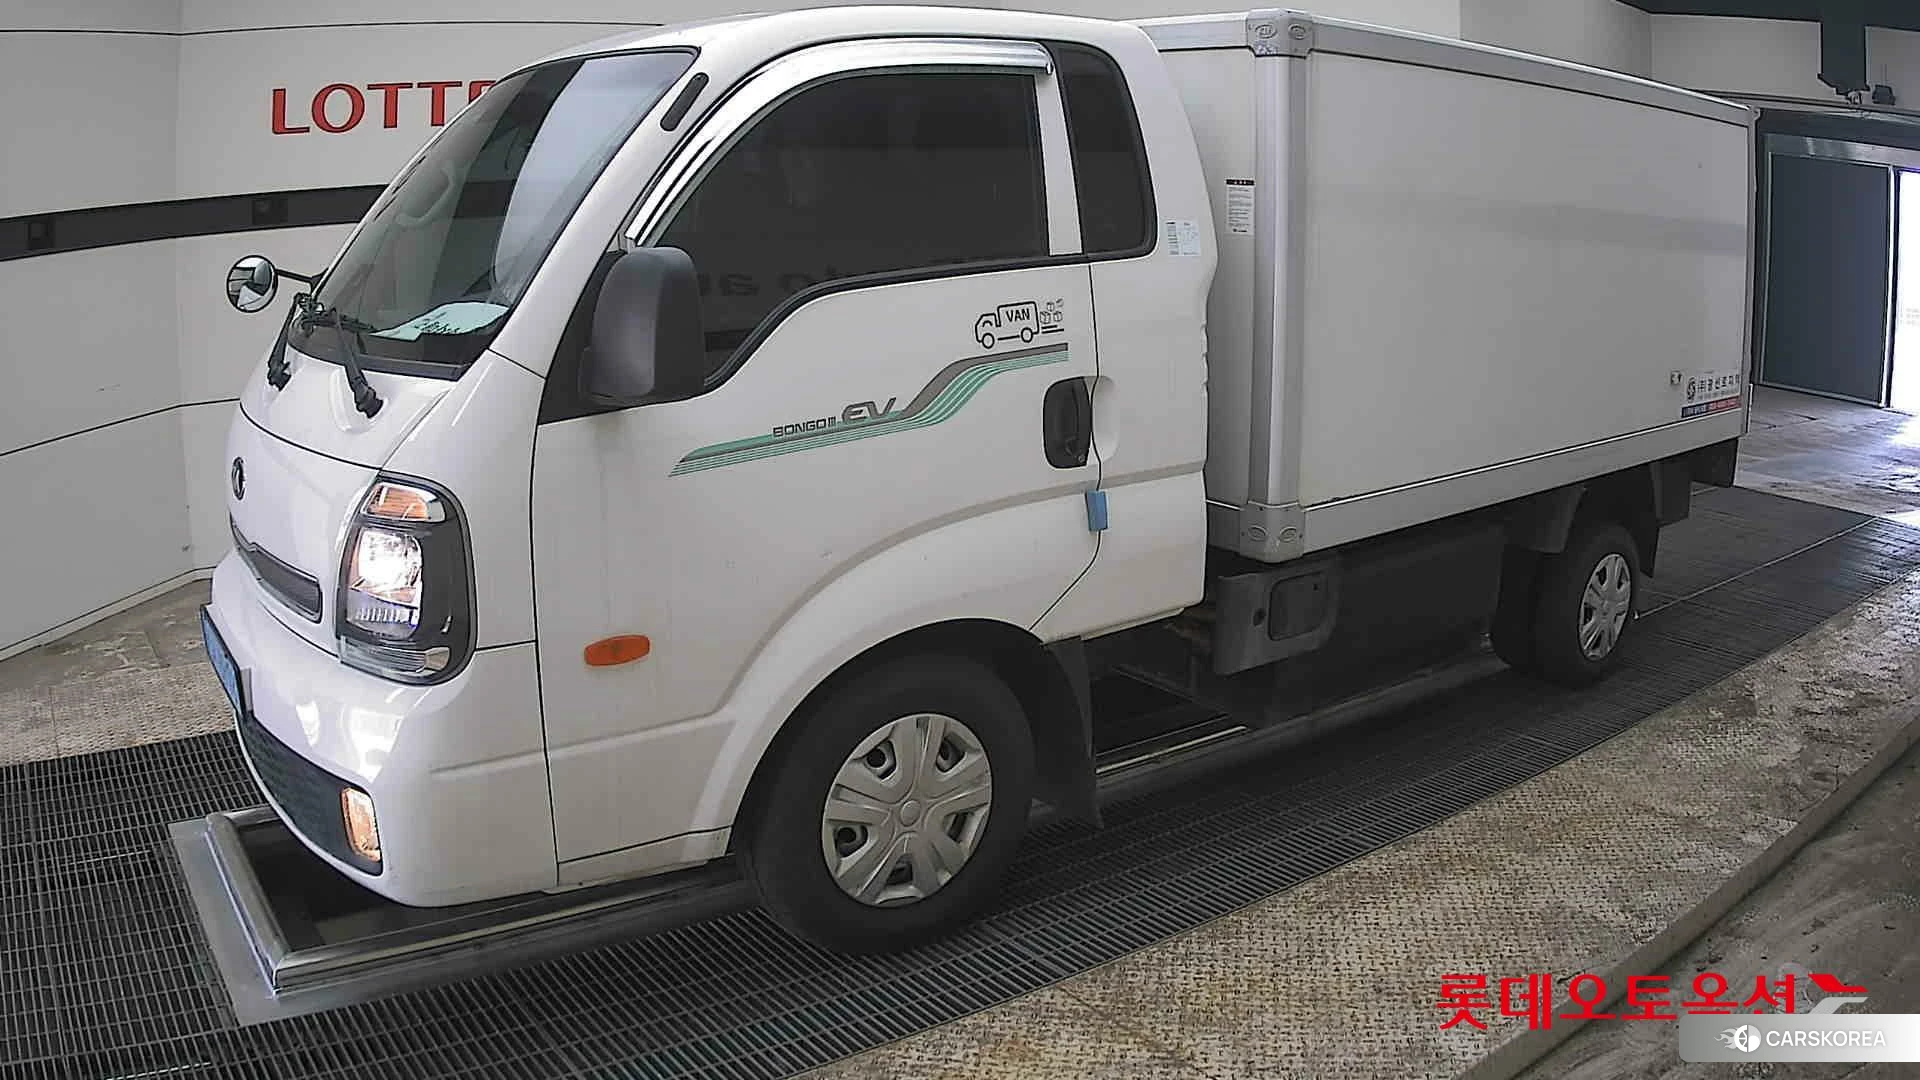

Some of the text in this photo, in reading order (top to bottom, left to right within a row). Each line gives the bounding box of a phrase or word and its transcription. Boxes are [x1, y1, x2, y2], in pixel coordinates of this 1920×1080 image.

[1005, 307, 1031, 323] VAN
[772, 418, 827, 438] BONGO
[841, 396, 897, 422] EV
